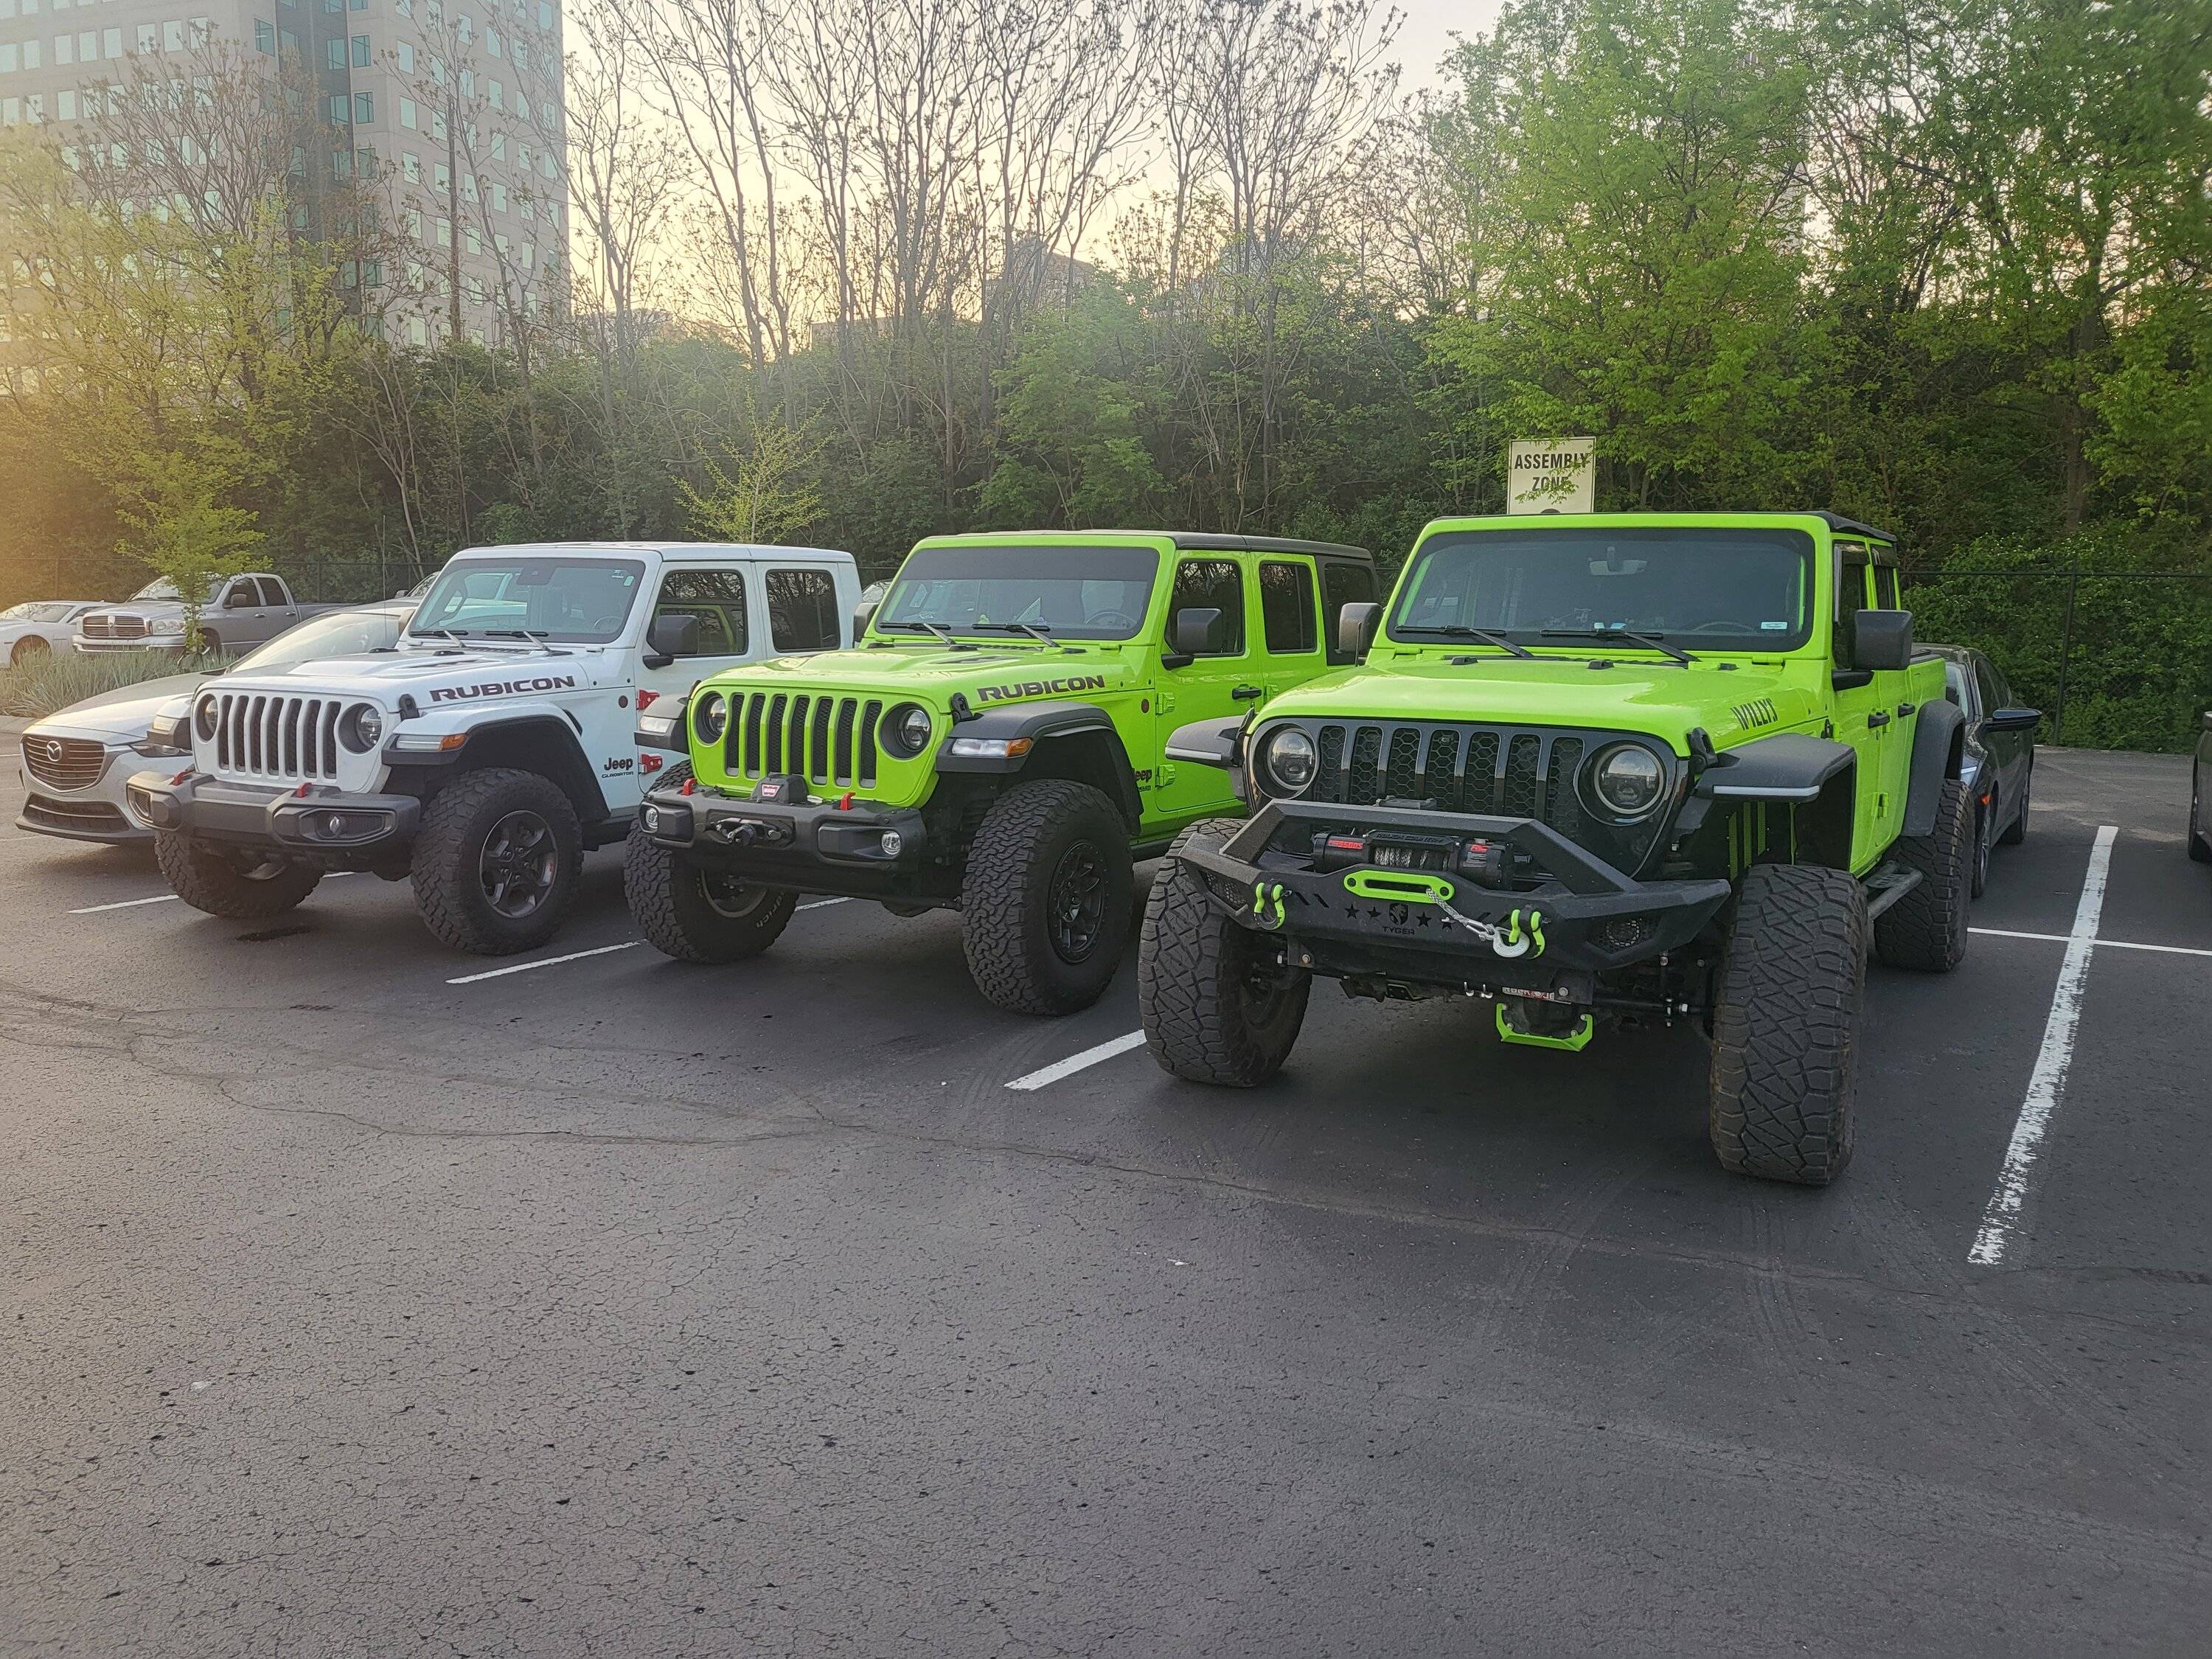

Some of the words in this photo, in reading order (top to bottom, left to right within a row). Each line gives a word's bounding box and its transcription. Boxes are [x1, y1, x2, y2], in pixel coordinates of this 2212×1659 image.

[1514, 453, 1588, 469] ASSEMBLY
[430, 675, 575, 702] RUBICON
[977, 675, 1105, 701] RUBICON
[1730, 697, 1778, 731] WILLYS
[604, 757, 633, 771] Jeep
[1131, 768, 1152, 782] eep
[1382, 925, 1415, 936] TYGER
